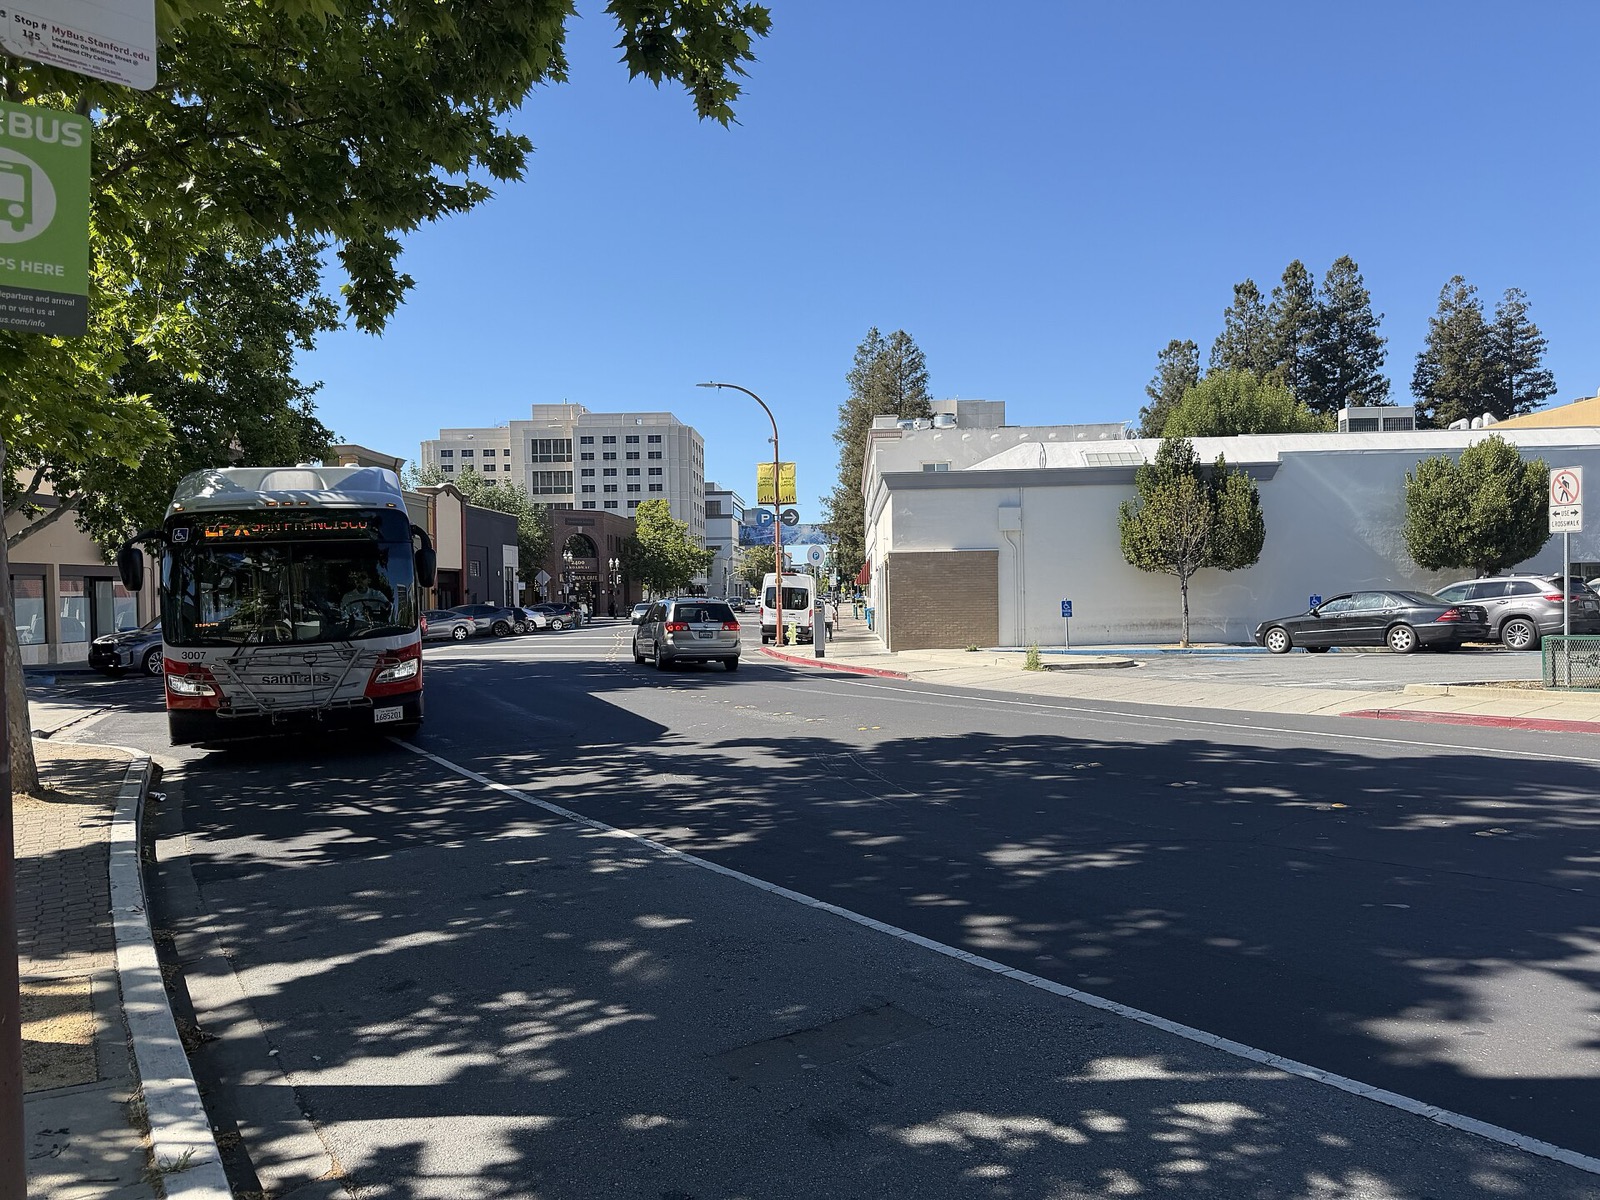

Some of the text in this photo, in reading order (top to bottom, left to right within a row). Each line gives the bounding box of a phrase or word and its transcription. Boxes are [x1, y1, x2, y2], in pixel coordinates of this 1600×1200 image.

[14, 14, 47, 31] Stop #
[52, 25, 150, 62] MyBus.Stanford.edu
[52, 35, 79, 48] Location:
[89, 47, 114, 58] Winslow
[115, 54, 132, 64] Street
[52, 42, 80, 55] Redwood
[81, 51, 92, 60] City
[93, 54, 116, 66] Caltrain
[0, 108, 82, 147] BUS
[21, 260, 65, 277] HERE
[35, 295, 50, 304] and
[51, 298, 75, 306] arrival
[18, 306, 35, 314] visit
[761, 514, 770, 524] P
[1551, 520, 1580, 528] CROSSWALK
[181, 651, 207, 661] 3007
[261, 671, 331, 684] samTrans
